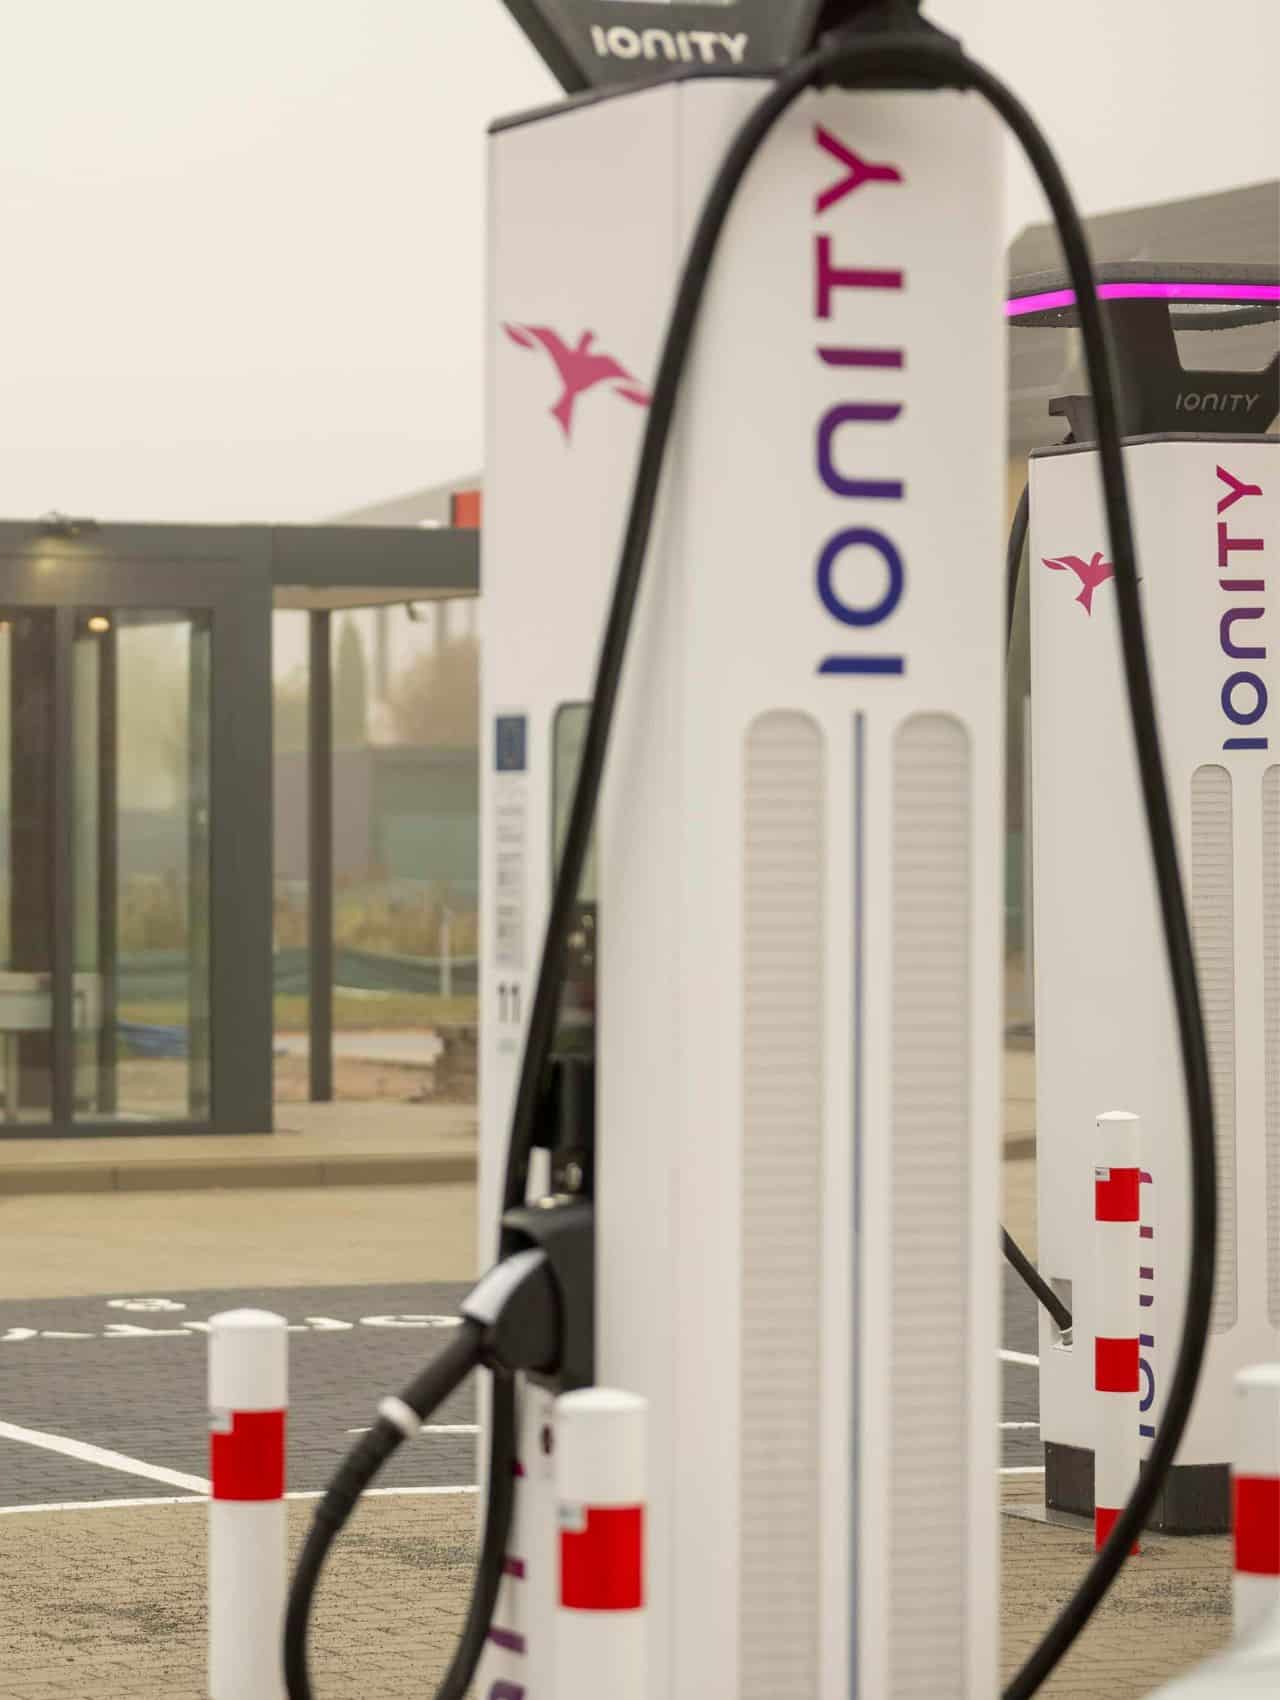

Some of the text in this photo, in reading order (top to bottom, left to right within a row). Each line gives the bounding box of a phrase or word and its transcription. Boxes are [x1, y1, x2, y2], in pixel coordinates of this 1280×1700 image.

[593, 26, 748, 64] IONITY
[816, 122, 904, 675] IONITY
[1175, 393, 1261, 412] IONITY
[1216, 464, 1269, 750] IONITY
